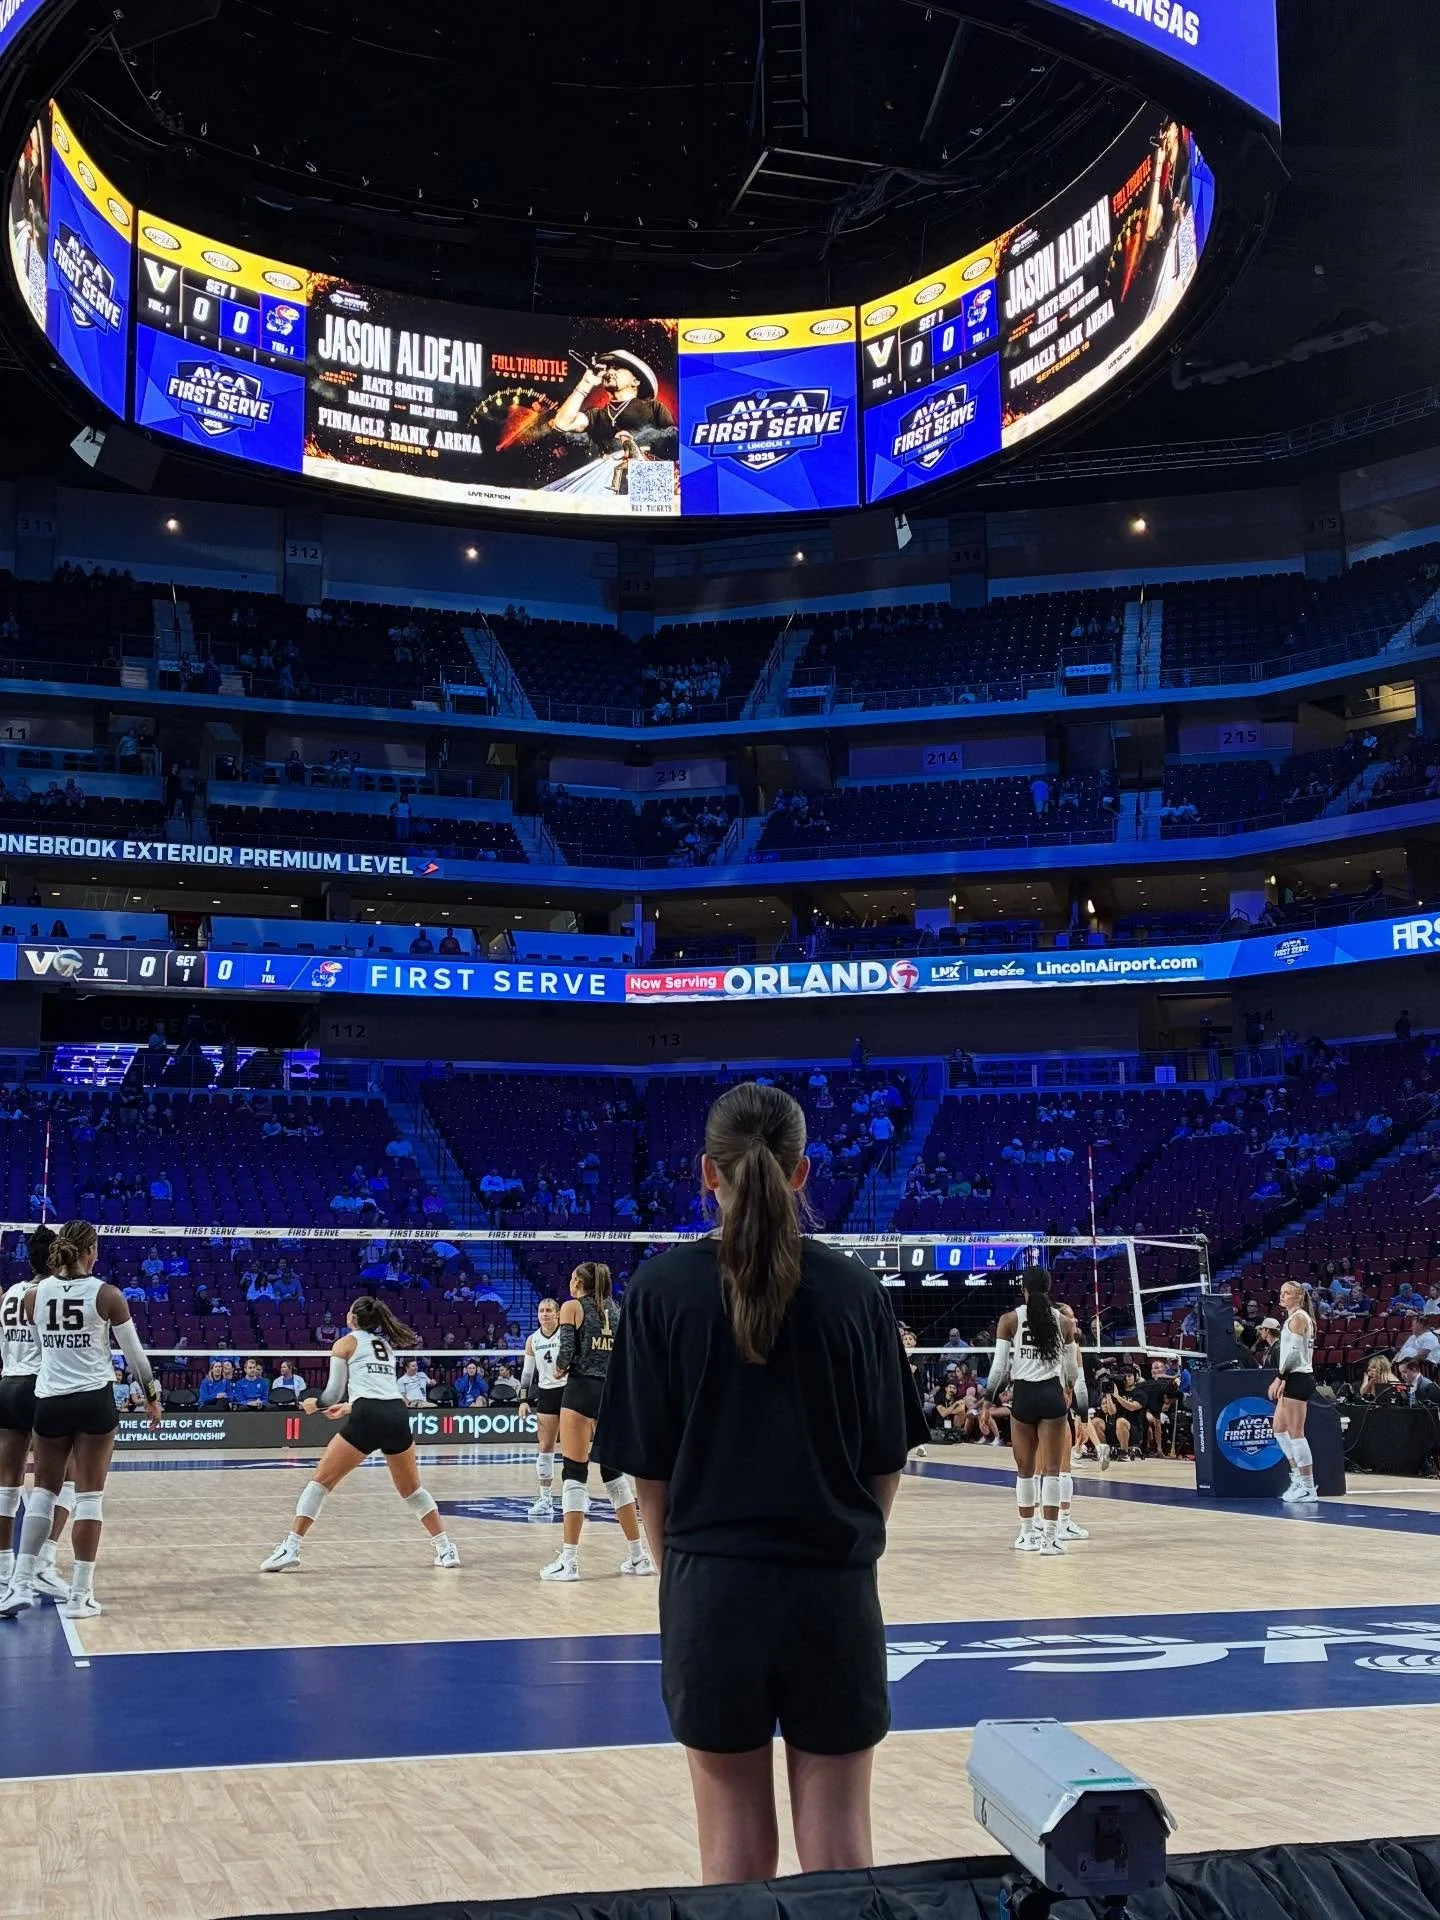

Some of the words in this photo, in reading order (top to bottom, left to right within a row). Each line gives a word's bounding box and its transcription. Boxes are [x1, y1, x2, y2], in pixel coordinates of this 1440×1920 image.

[1006, 242, 1056, 318] JASON
[1059, 195, 1110, 283] ALDEAN
[54, 239, 82, 287] FIRST
[82, 276, 120, 327] SERVE
[206, 279, 228, 296] SET
[193, 297, 210, 321] 0
[233, 311, 249, 334] 0
[919, 312, 936, 331] SET
[943, 326, 954, 352] 0
[318, 314, 391, 372] JASON
[396, 330, 483, 387] ALDEAN
[910, 341, 923, 366] 0
[1009, 344, 1056, 389] PINNACLE
[1058, 323, 1084, 358] BANK
[492, 354, 515, 371] FULL
[516, 357, 567, 376] THROTTLE
[1036, 348, 1080, 384] SEPTEMBER
[191, 367, 246, 396] AVCA
[362, 375, 393, 395] NATE
[395, 380, 434, 403] SMITH
[169, 378, 216, 405] FIRST
[218, 392, 270, 420] SERVE
[727, 394, 808, 421] AVCA
[912, 392, 957, 429] AVCA
[318, 407, 384, 438] PINNACLE
[391, 423, 430, 446] BANK
[434, 430, 482, 454] ARENA
[695, 420, 763, 444] FIRST
[767, 411, 842, 438] SERVE
[894, 423, 932, 455] FIRST
[934, 401, 974, 437] SERVE
[355, 436, 423, 455] SEPTEMBER
[747, 441, 782, 449] LINCOLN
[748, 453, 775, 462] 2025
[290, 545, 319, 559] 312
[1223, 730, 1256, 744] 215
[927, 752, 958, 766] 214
[656, 769, 688, 784] 213
[123, 841, 232, 864] EXTERIOR
[240, 848, 340, 870] PREMIUM
[348, 854, 413, 874] LEVEL
[98, 953, 104, 965] 1
[140, 956, 156, 977] 0
[176, 956, 196, 966] SET
[266, 960, 271, 972] 1
[1037, 956, 1197, 975] LincolnAirport.com
[93, 968, 108, 977] TOL
[183, 969, 190, 982] 1
[218, 960, 233, 980] 0
[262, 974, 275, 984] TOL
[932, 965, 959, 979] LNK
[974, 966, 1024, 977] Breeze
[371, 966, 474, 990] FIRST
[493, 971, 605, 995] SERVE
[630, 977, 661, 989] Now
[665, 975, 716, 989] Serving
[330, 1024, 366, 1038] 112
[648, 1033, 680, 1047] 113
[912, 1249, 924, 1266] 0
[950, 1249, 961, 1266] 0
[46, 1299, 84, 1331] 15
[601, 1309, 612, 1335] 1
[42, 1334, 91, 1348] BOWSER
[372, 1340, 389, 1361] 8
[544, 1350, 553, 1363] 4
[119, 1420, 137, 1429] THE
[140, 1420, 176, 1429] CETER
[179, 1420, 192, 1428] OF
[195, 1420, 224, 1428] EVERY
[1237, 1418, 1271, 1429] AVCA
[159, 1432, 225, 1441] CHAMPIONSHIP
[1224, 1430, 1253, 1441] FIRST
[1080, 1860, 1087, 1872] 6
